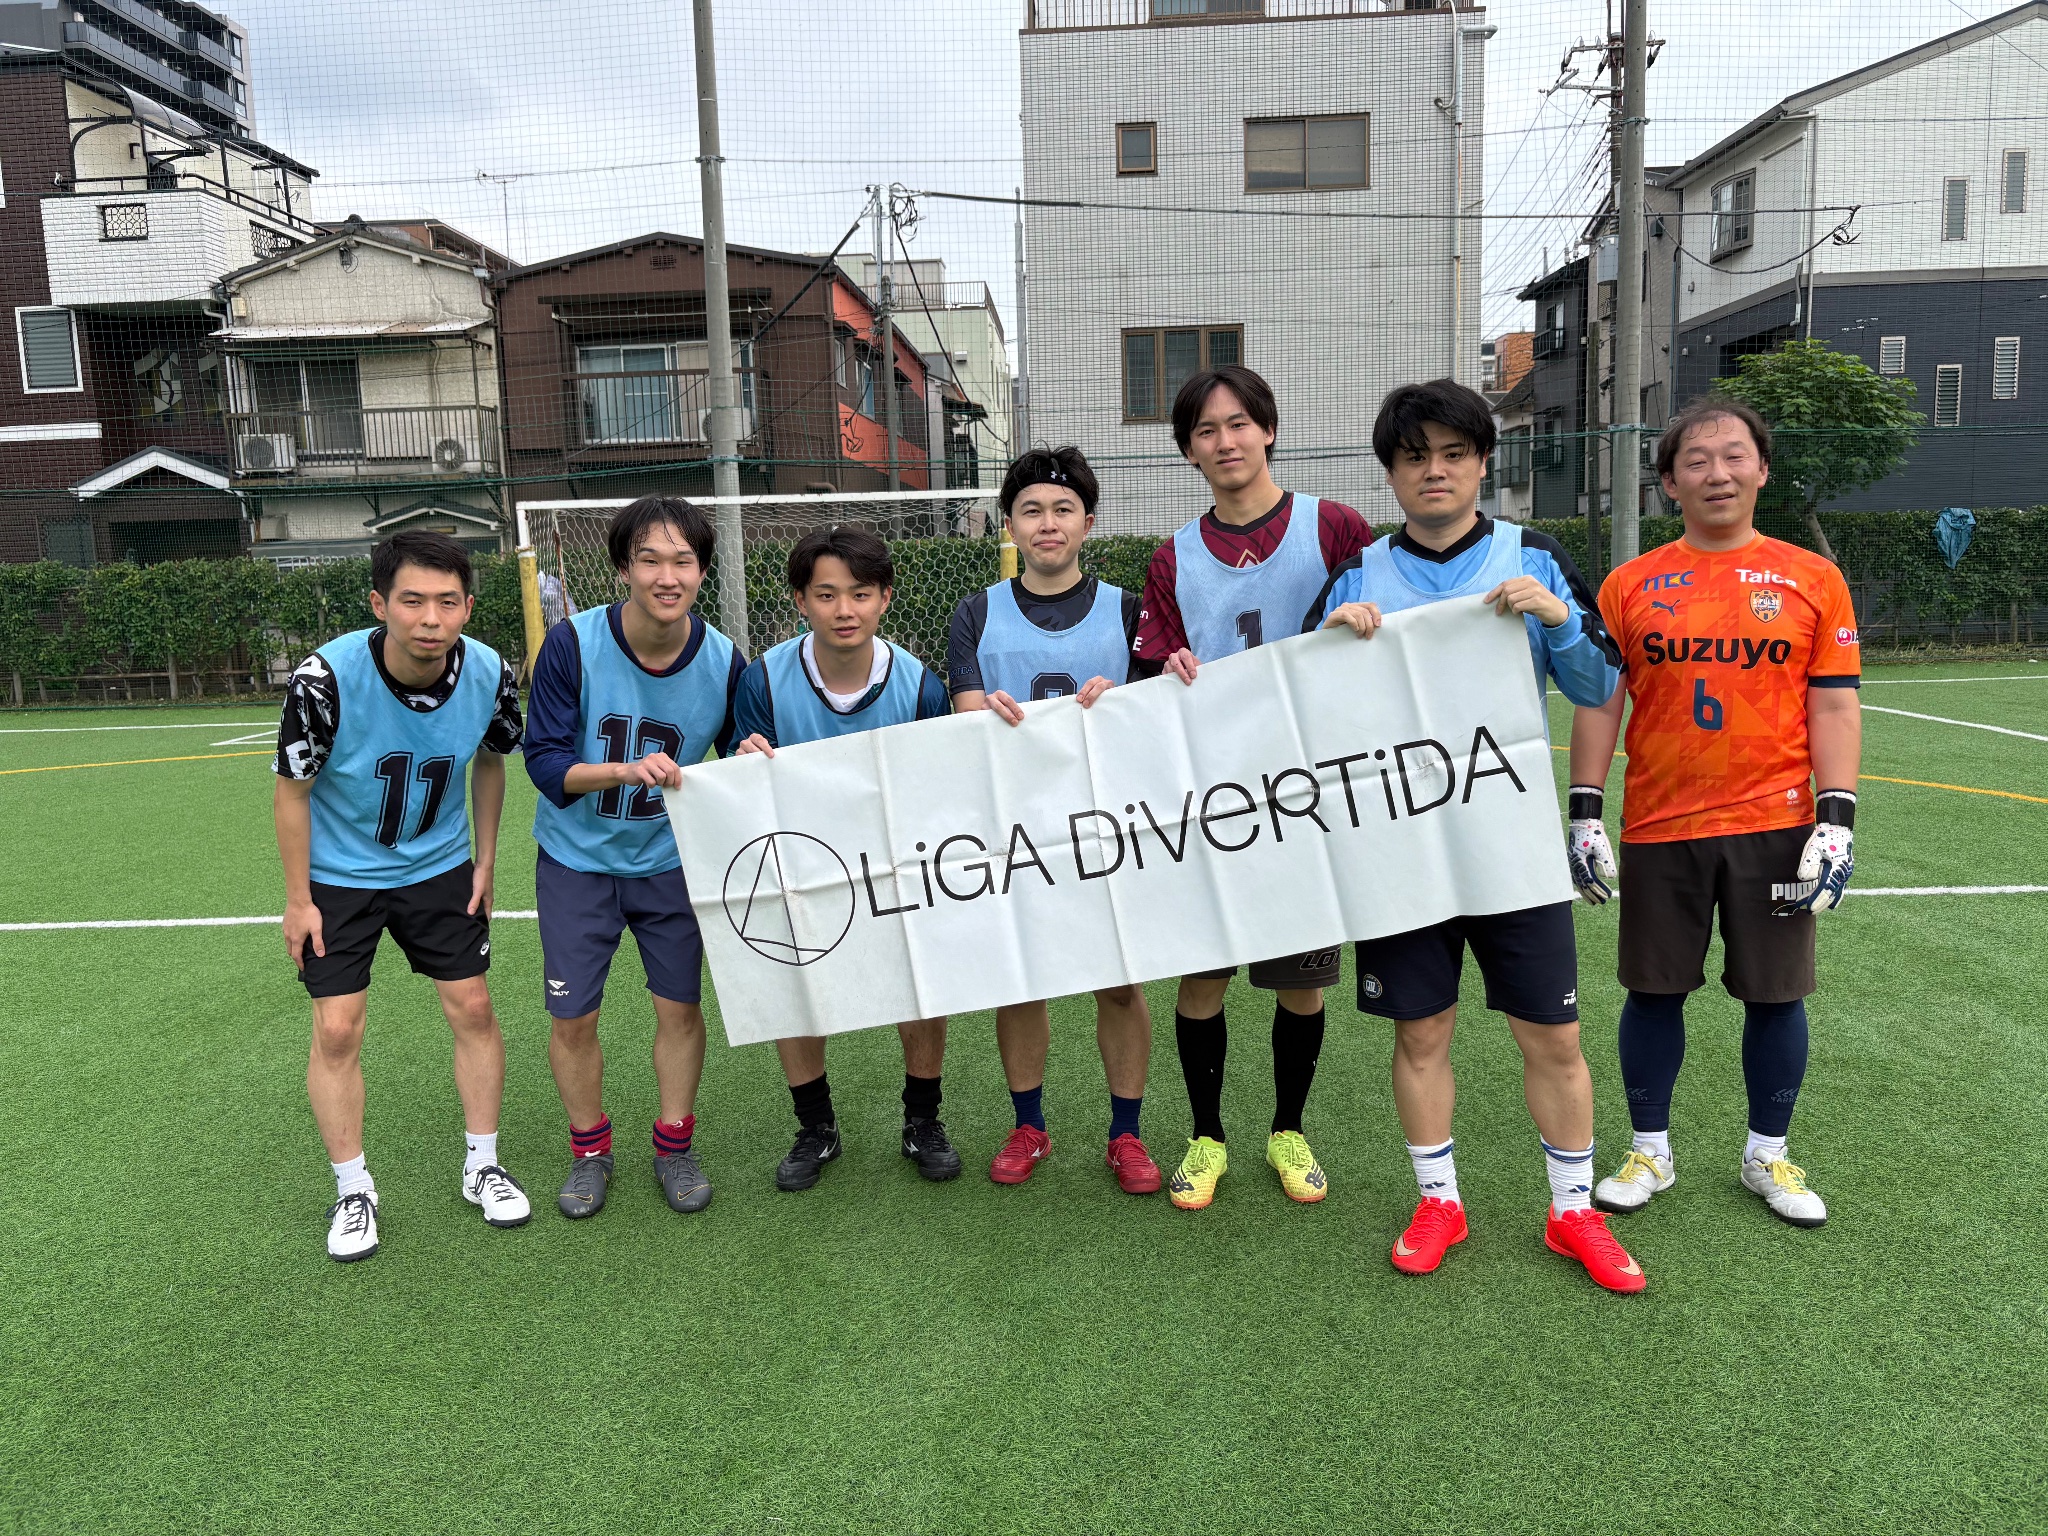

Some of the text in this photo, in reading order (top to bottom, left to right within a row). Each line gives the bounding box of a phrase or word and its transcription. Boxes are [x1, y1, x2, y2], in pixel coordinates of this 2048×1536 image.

[1642, 631, 1792, 670] Suzuyo
[374, 750, 456, 850] 11
[596, 713, 685, 821] 12
